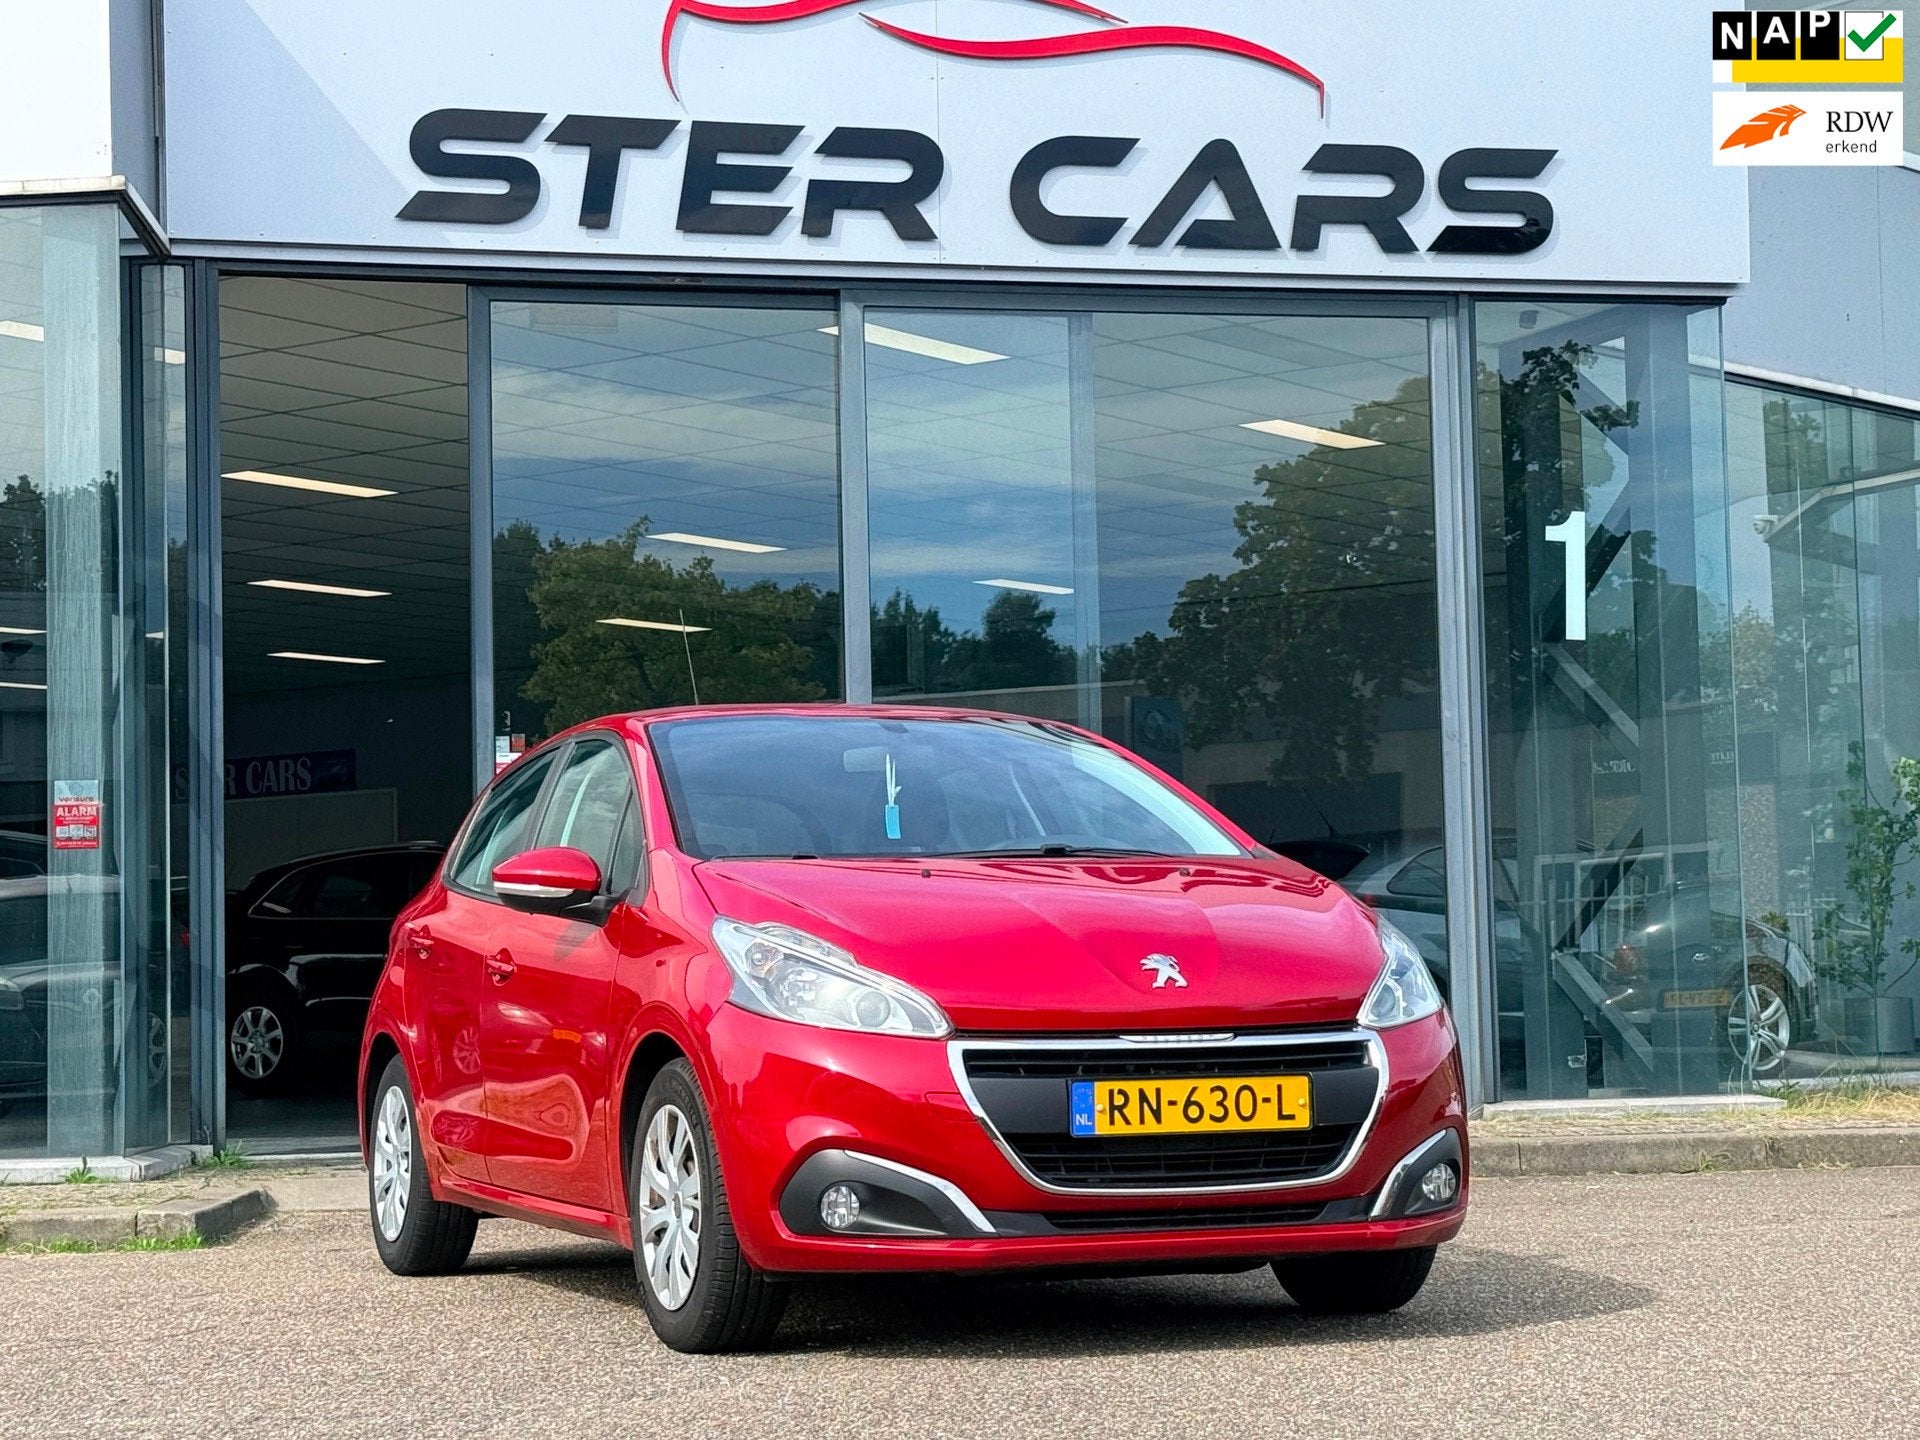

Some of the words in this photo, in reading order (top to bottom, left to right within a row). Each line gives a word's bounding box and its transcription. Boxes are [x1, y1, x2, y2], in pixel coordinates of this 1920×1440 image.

[394, 107, 945, 241] STER
[1009, 134, 1560, 255] CARS
[1545, 511, 1586, 641] 1
[245, 757, 312, 795] CARS
[56, 806, 97, 817] ALARM
[1075, 1113, 1093, 1126] NL
[1108, 1083, 1296, 1126] RN-630-L
